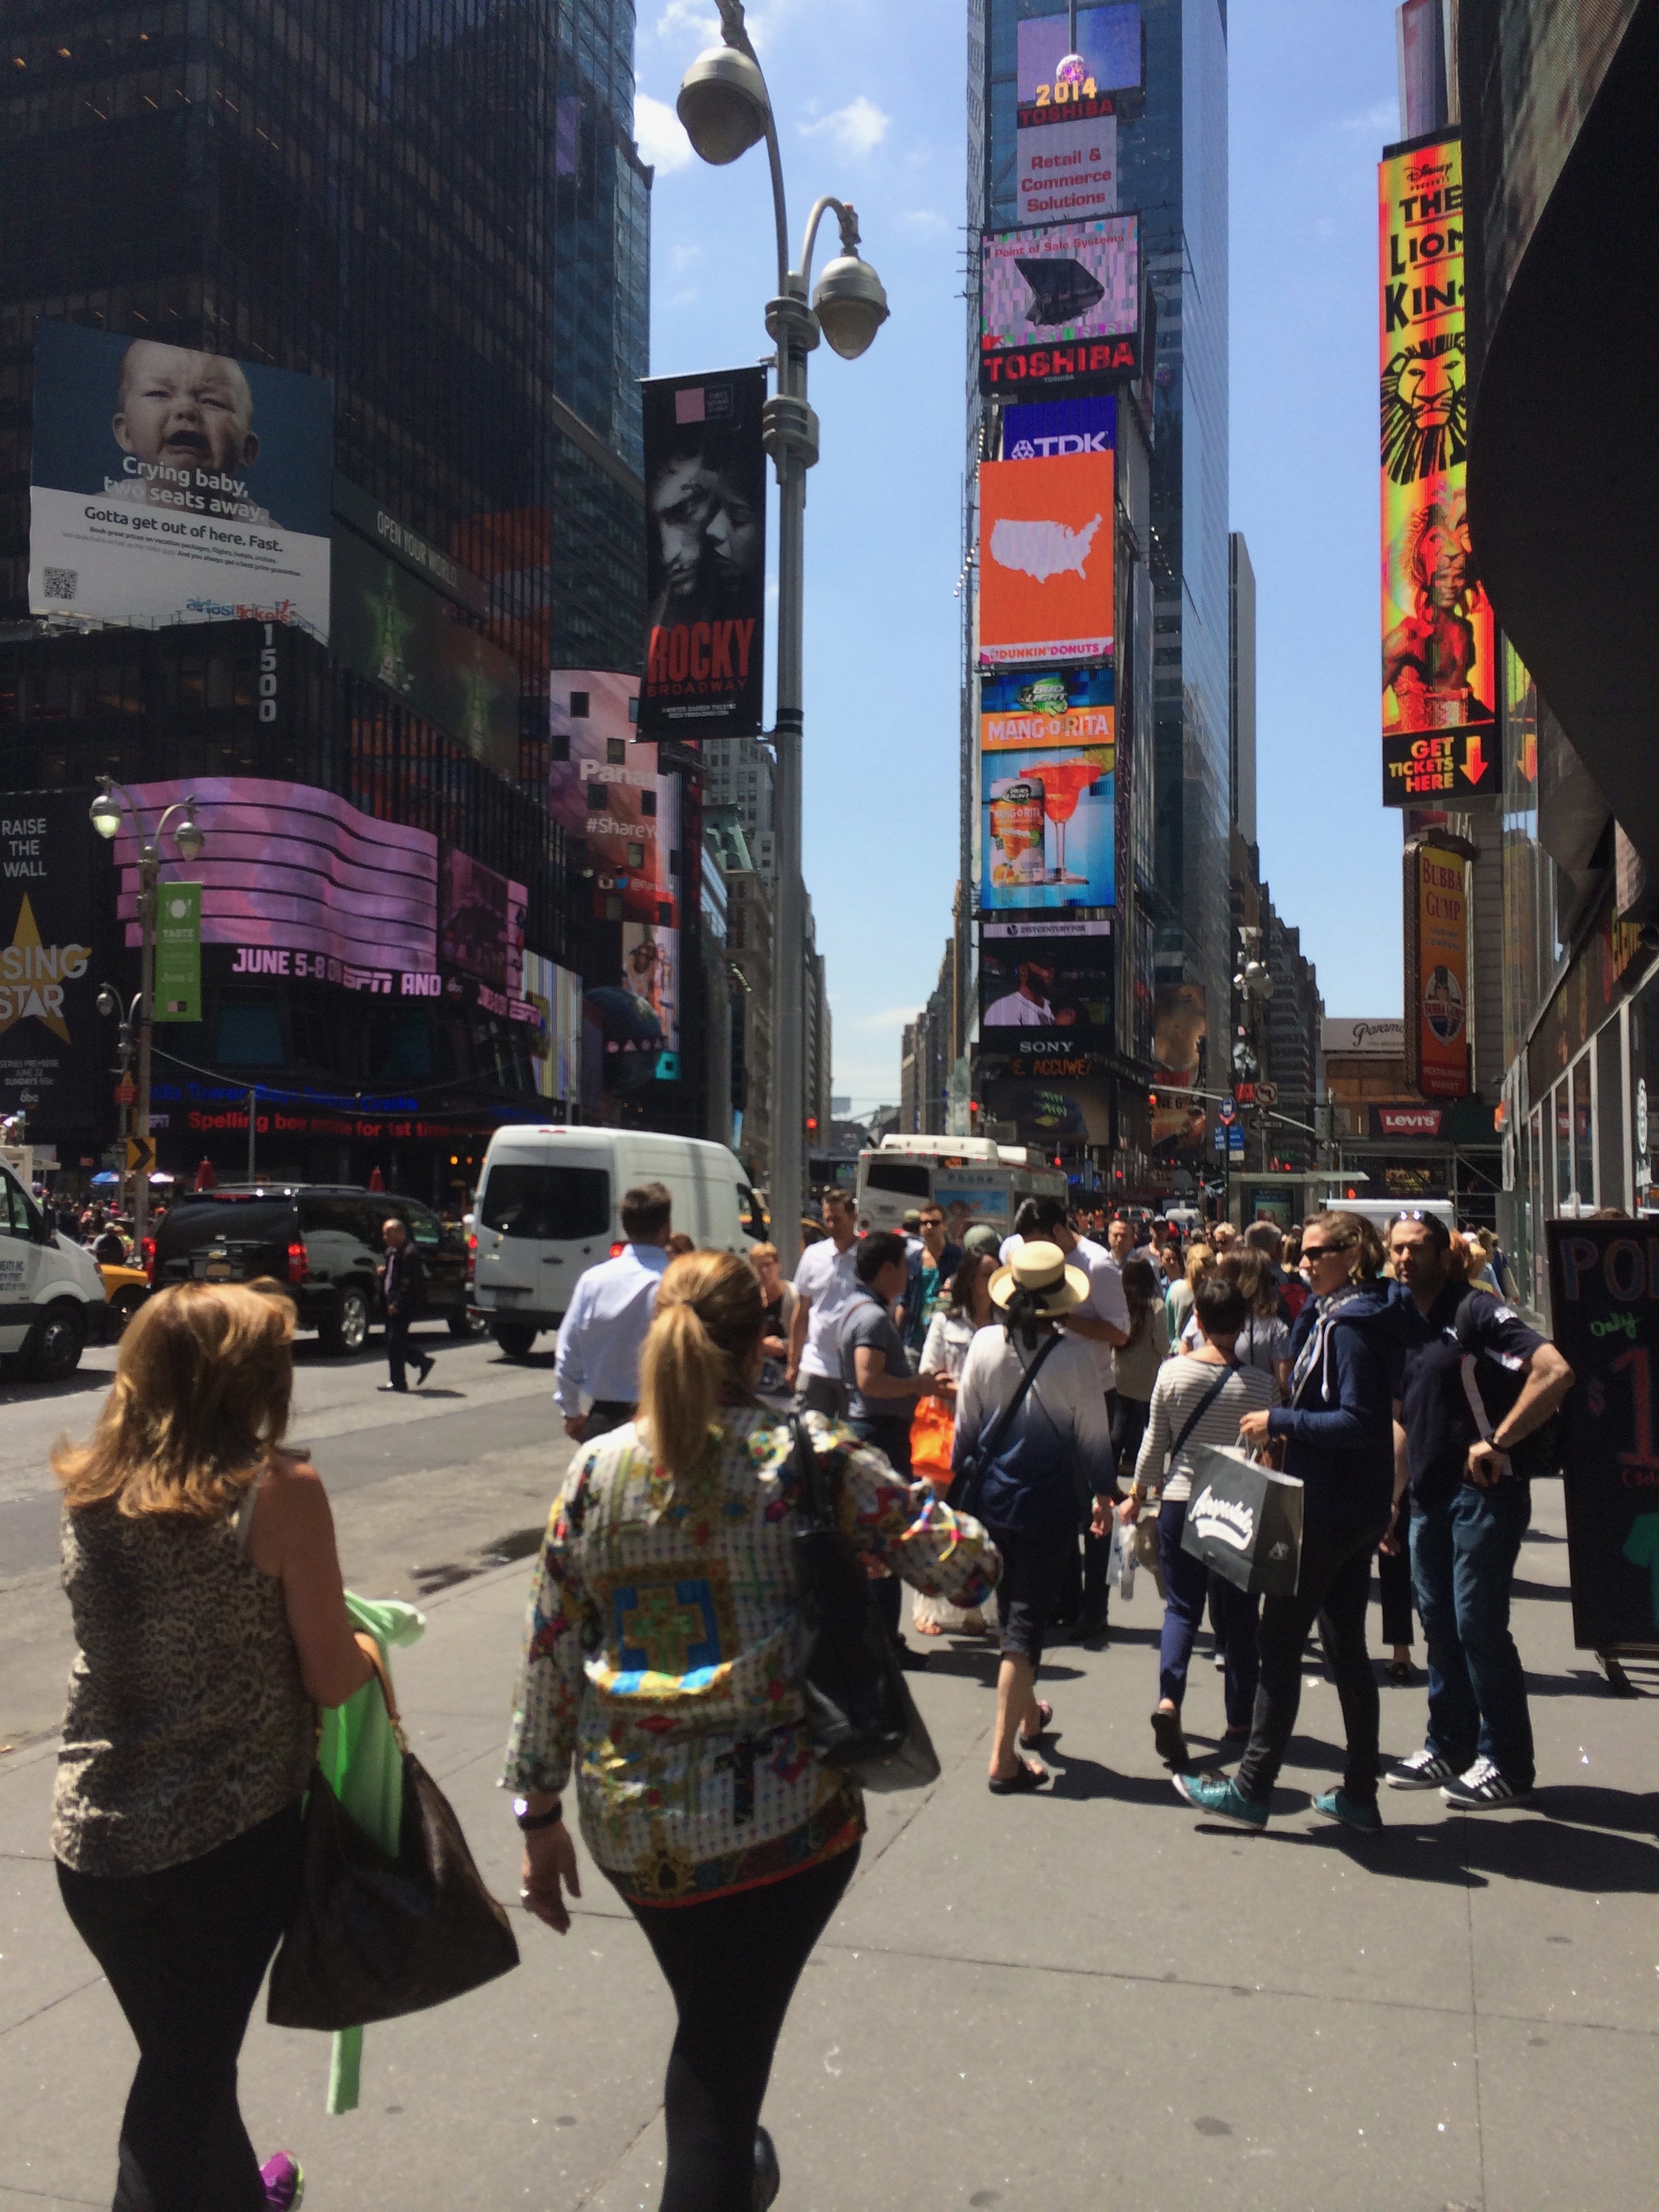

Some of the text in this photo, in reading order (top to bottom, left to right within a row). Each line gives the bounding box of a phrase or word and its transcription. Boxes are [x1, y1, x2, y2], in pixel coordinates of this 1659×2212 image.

[1036, 77, 1097, 107] 2014
[1019, 98, 1113, 126] TOSHIBA
[1031, 147, 1101, 169] Retail &
[1021, 169, 1112, 192] Commerce
[1027, 191, 1105, 213] Solutions
[1399, 184, 1462, 222] THE
[995, 234, 1124, 258] Point of Sale Systems
[1385, 279, 1465, 333] KIN
[983, 342, 1135, 382] TOSHIBA
[1033, 430, 1109, 457] TDK
[123, 456, 248, 497] Crying baby,
[104, 476, 144, 498] two
[150, 487, 204, 509] seats
[84, 506, 283, 552] Gotta get out of here. Fast.
[647, 617, 756, 684] ROCKY
[999, 643, 1099, 659] DUNKIN' DONUTS
[258, 623, 278, 722] 1500
[646, 678, 746, 697] BROADWAY
[988, 715, 1109, 741] MANG-O-RITA
[1410, 737, 1454, 759] GET
[1389, 758, 1454, 778] TICKETS
[1406, 773, 1454, 793] HERE
[1, 818, 47, 836] RAISE
[586, 817, 656, 839] #ShareY
[9, 840, 39, 856] THE
[3, 861, 47, 878] WALL
[1422, 857, 1464, 893] BUBBA
[1426, 891, 1461, 922] GUMP
[3, 944, 87, 980] SING
[231, 947, 291, 975] JUNE
[342, 965, 392, 994] ESPN
[401, 973, 442, 997] AND
[1019, 1041, 1074, 1053] SONY
[188, 1110, 270, 1134] Spelling
[355, 1120, 382, 1137] for
